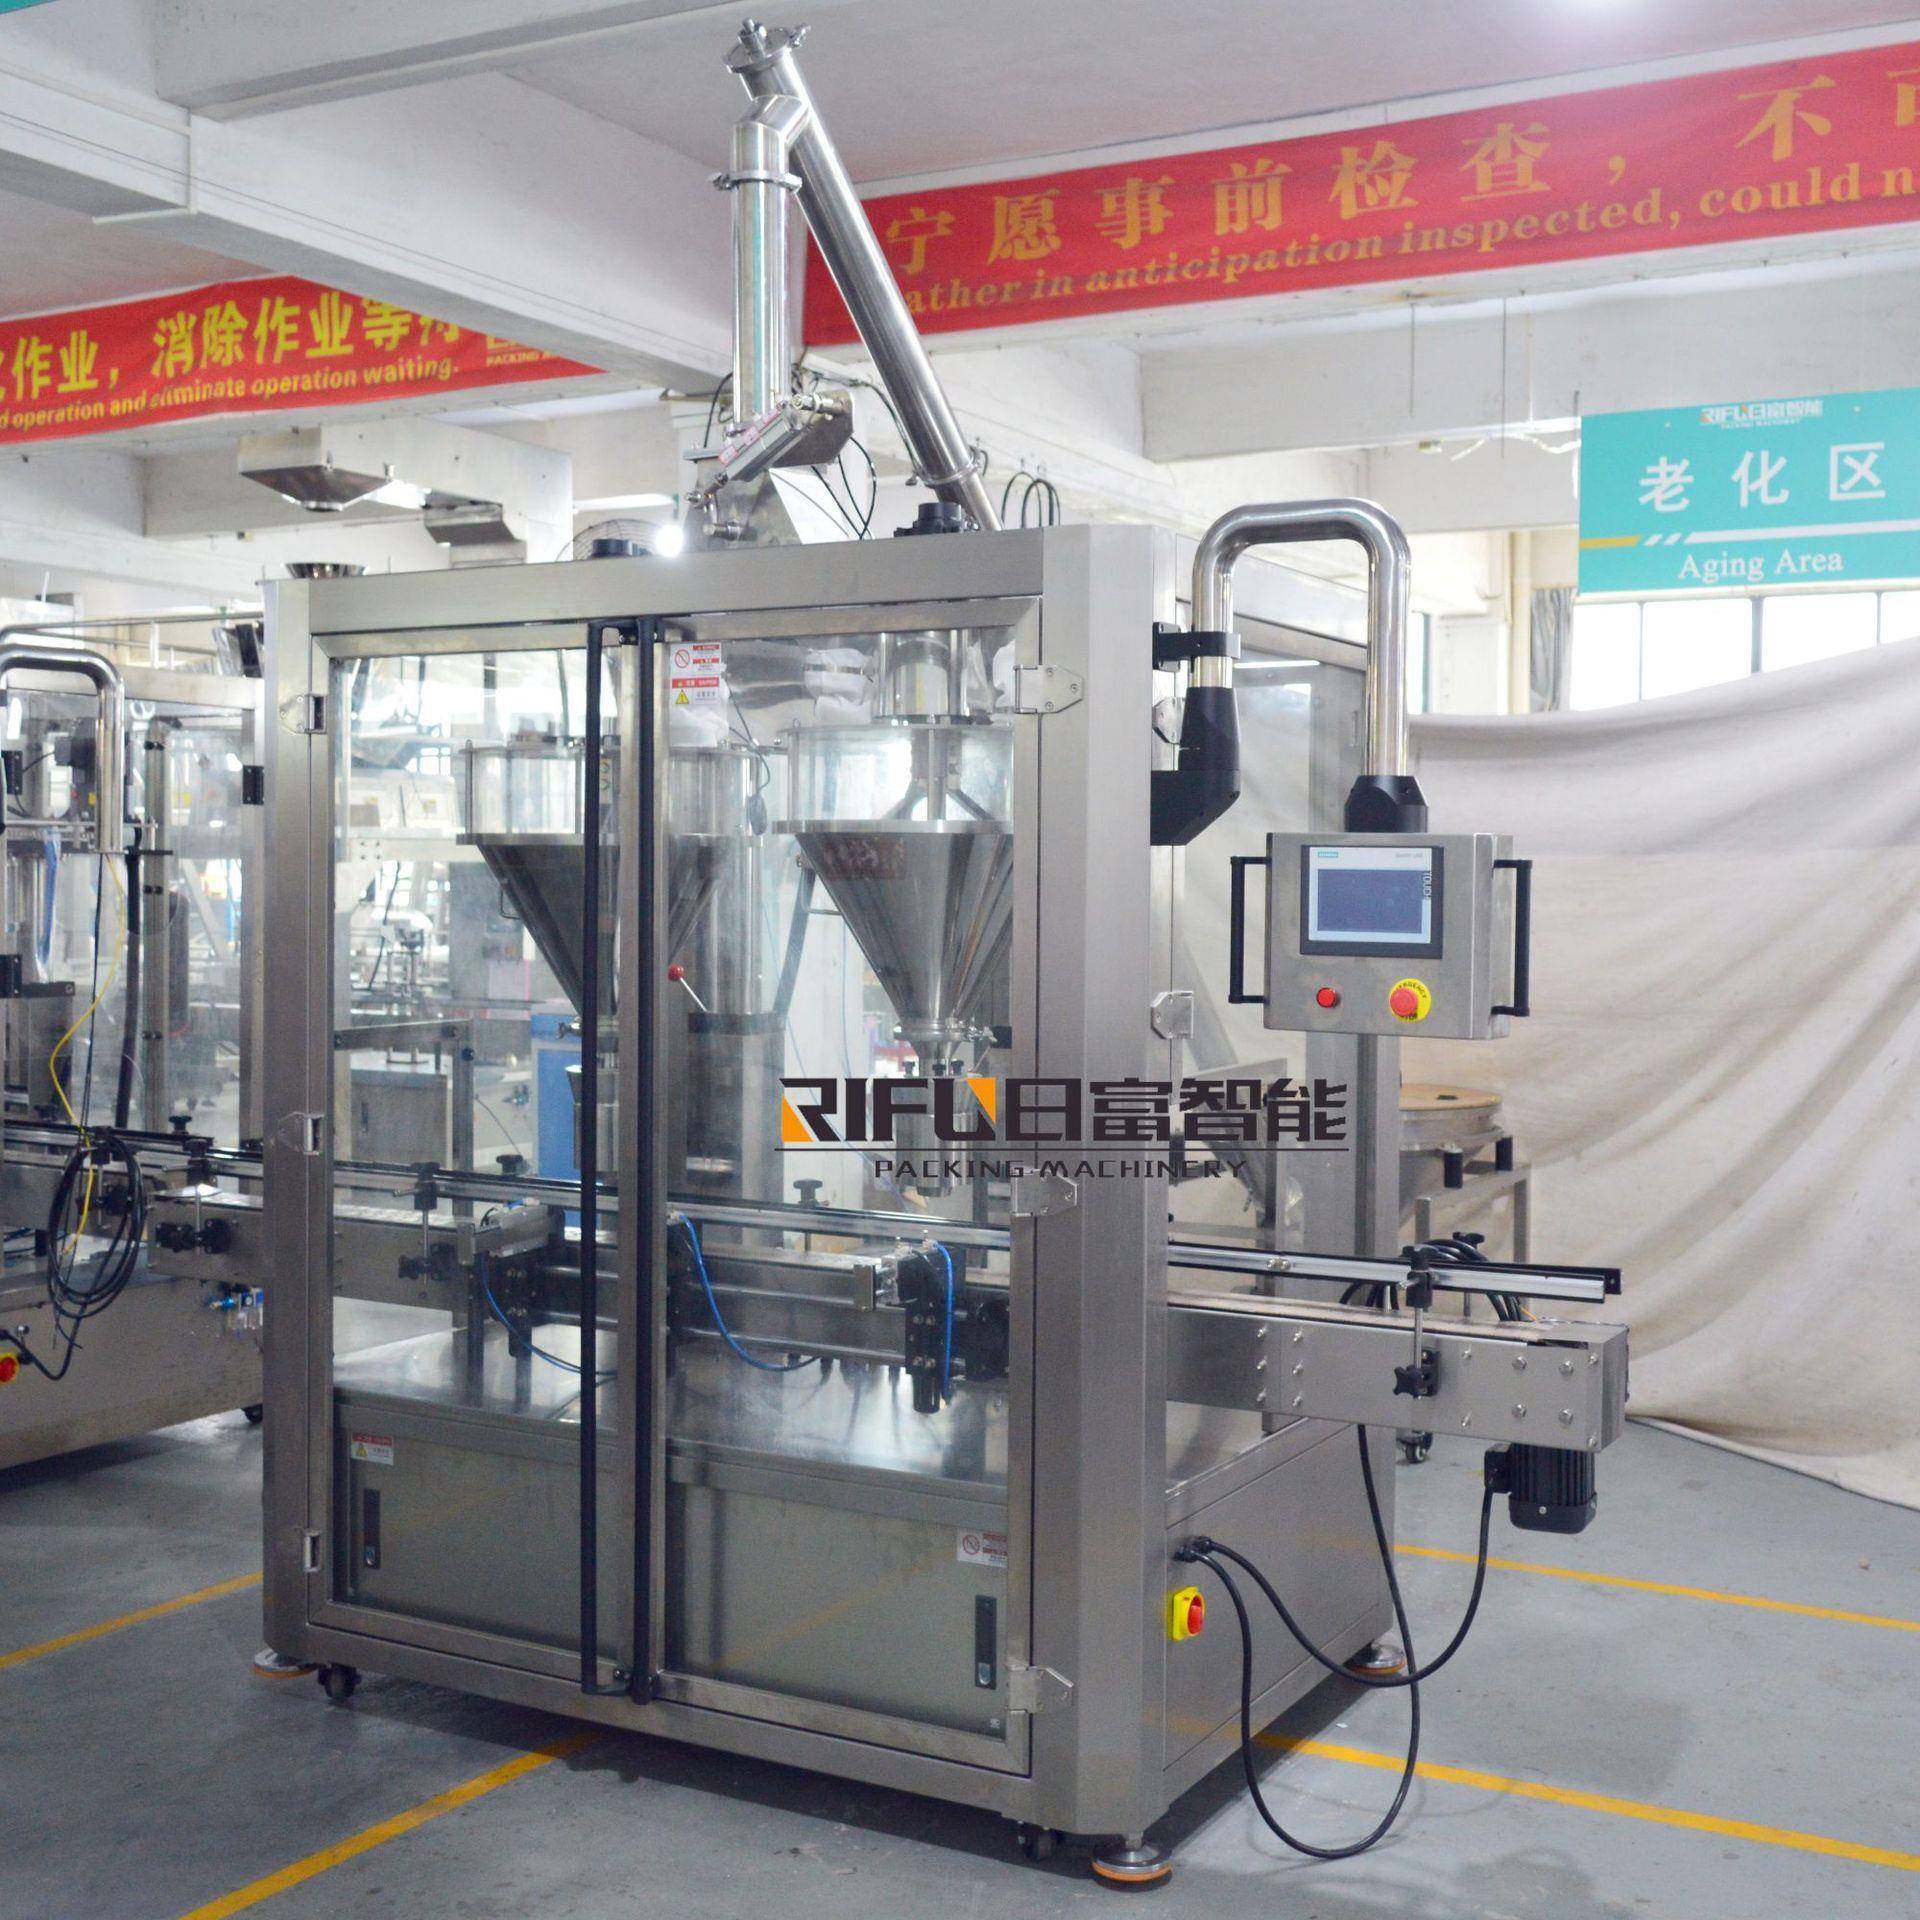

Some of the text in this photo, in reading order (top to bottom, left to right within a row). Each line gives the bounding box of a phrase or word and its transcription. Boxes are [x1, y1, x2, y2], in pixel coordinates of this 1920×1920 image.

[907, 277, 1021, 313] ather
[1031, 268, 1075, 299] in
[1085, 233, 1382, 292] anticipation
[1398, 187, 1681, 254] inspected,
[1699, 162, 1862, 218] could
[13, 400, 106, 432] operation
[110, 390, 148, 417] and
[252, 365, 357, 398] operation
[1638, 441, 1886, 513] 老化区
[1678, 548, 1844, 583] Aging Area
